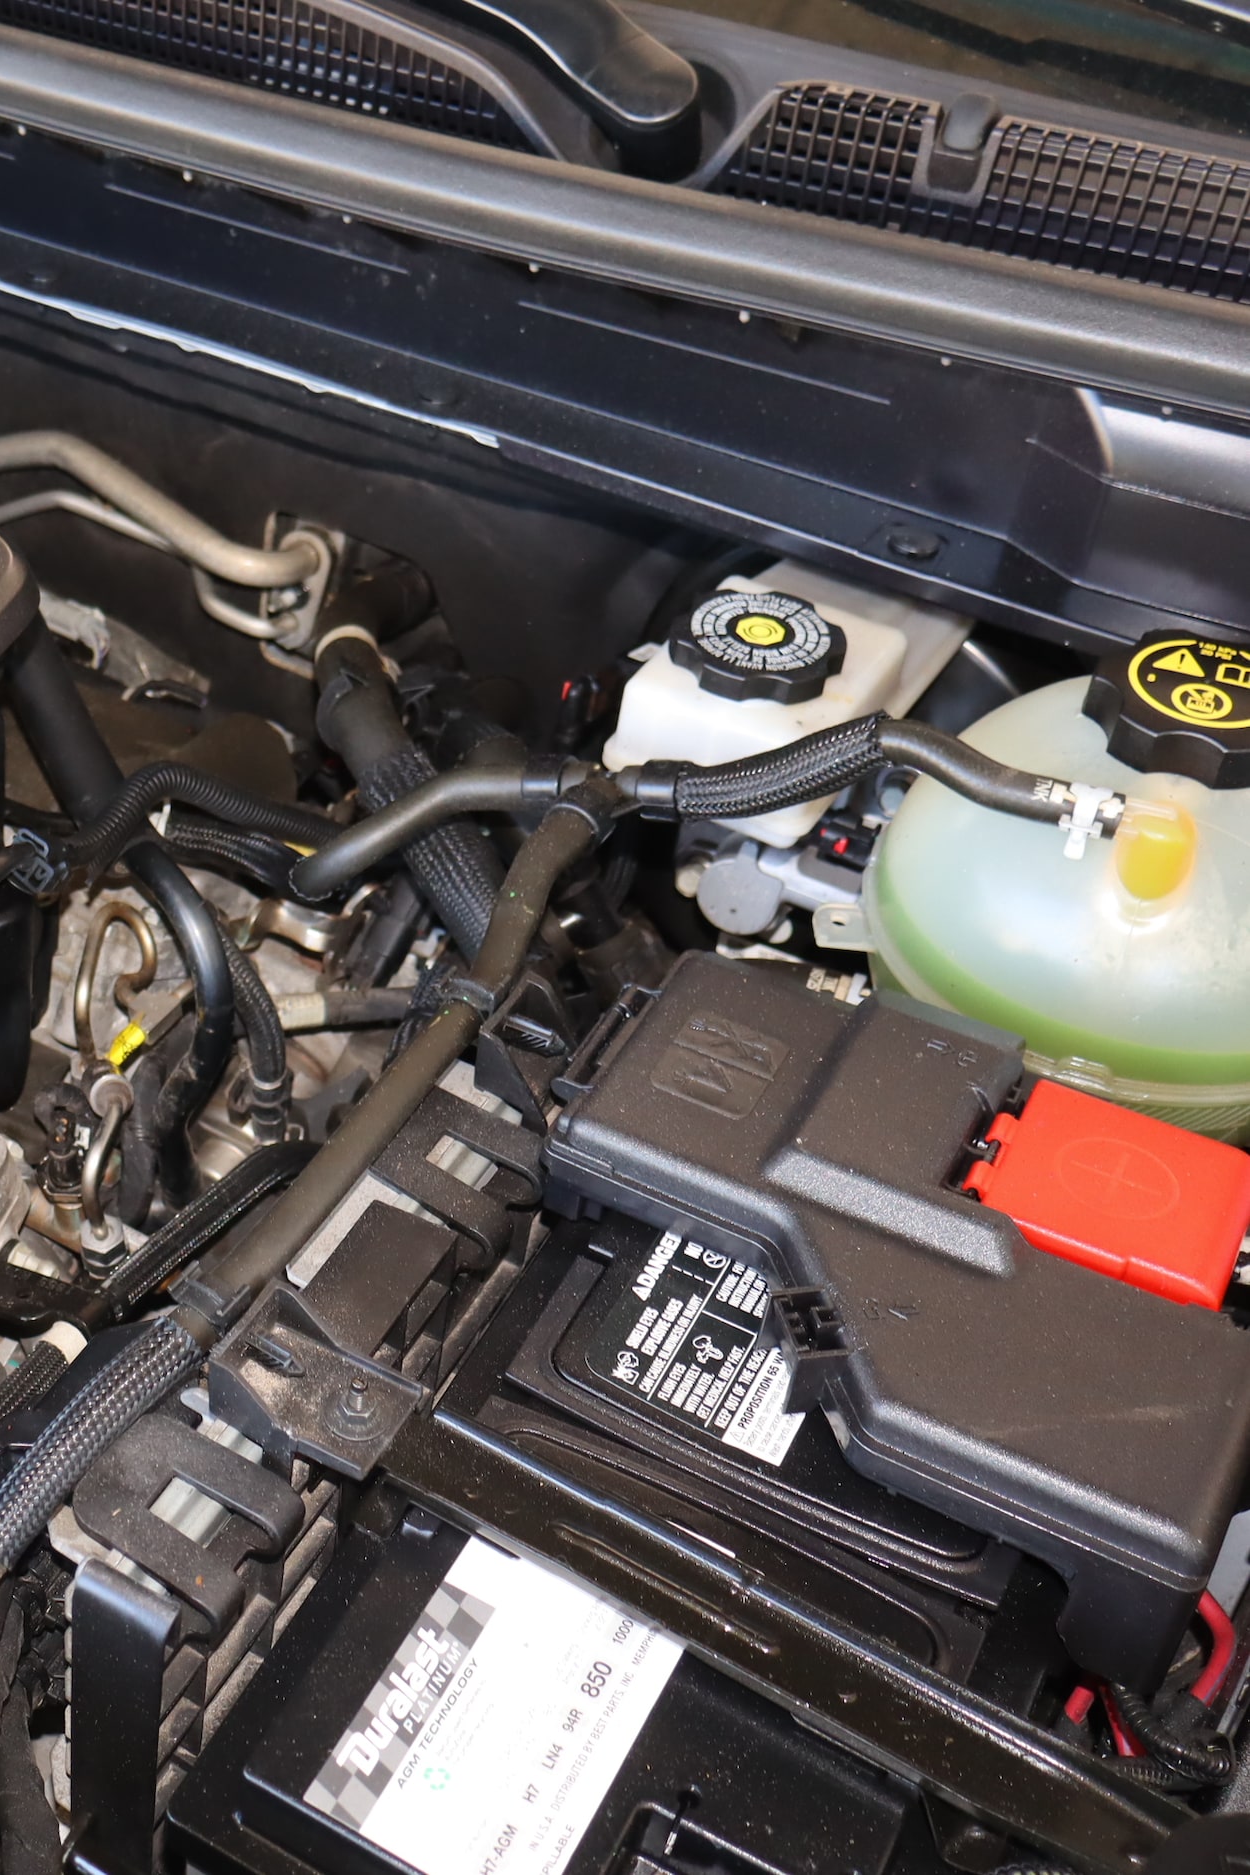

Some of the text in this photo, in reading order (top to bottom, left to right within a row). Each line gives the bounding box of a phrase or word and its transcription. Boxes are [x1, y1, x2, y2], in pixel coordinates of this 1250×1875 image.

[739, 1287, 762, 1313] MANUAL
[625, 1306, 659, 1349] SHIELD EYES
[638, 1293, 703, 1393] CAN CAUSE BLINDNESS OR INJURY
[640, 1297, 683, 1356] EXPLOSIVE GASES
[657, 1361, 686, 1401] FLUSH EYES
[669, 1362, 701, 1407] IMMEDIATELY
[717, 1359, 736, 1381] HELP
[731, 1382, 746, 1396] OF
[737, 1367, 755, 1385] THE
[682, 1392, 701, 1413] WITH
[695, 1402, 711, 1419] GET
[701, 1375, 727, 1409] MEDICAL
[723, 1392, 741, 1411] OUT
[737, 1376, 772, 1428] PROPOSITION
[767, 1365, 779, 1375] 65
[713, 1407, 732, 1429] KEEP
[335, 1626, 451, 1777] Duralast
[521, 1783, 540, 1804] H7
[541, 1743, 564, 1770] LN4
[562, 1707, 584, 1733] 94R
[580, 1660, 613, 1698] 850
[612, 1618, 635, 1646] 1000
[397, 1753, 421, 1789] AGM
[418, 1657, 479, 1751] TECHNOLOGY
[550, 1750, 588, 1812] DISTRIBUTED
[582, 1739, 594, 1753] BY
[590, 1714, 609, 1740] BEST
[540, 1824, 576, 1875] PILLABLE
